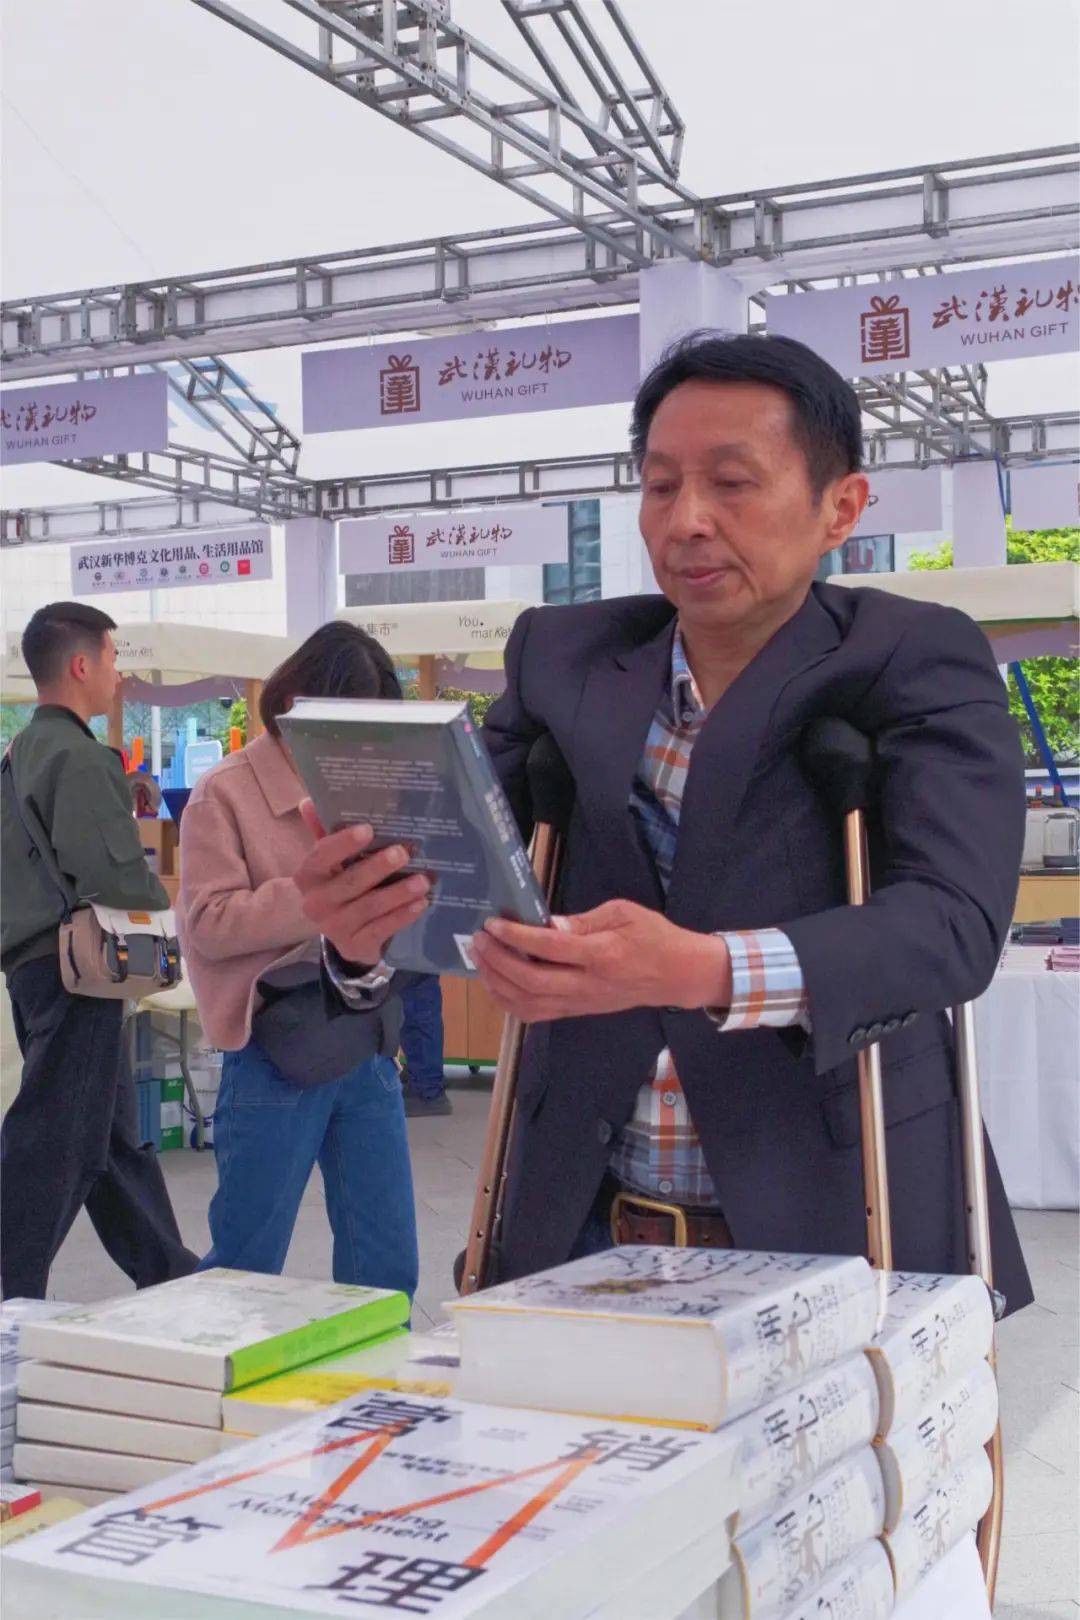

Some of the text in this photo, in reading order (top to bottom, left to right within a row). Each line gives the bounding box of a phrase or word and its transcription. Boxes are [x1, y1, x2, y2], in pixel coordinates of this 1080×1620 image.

[961, 322, 1069, 346] WUHAN GIFT
[461, 382, 549, 402] WUHAN GIFT
[6, 433, 77, 450] WUHAN GIFT
[440, 547, 498, 559] WUHAN GIFT
[228, 1497, 451, 1543] Management
[275, 1490, 446, 1530] Marketing
[57, 1507, 488, 1614] 管 理
